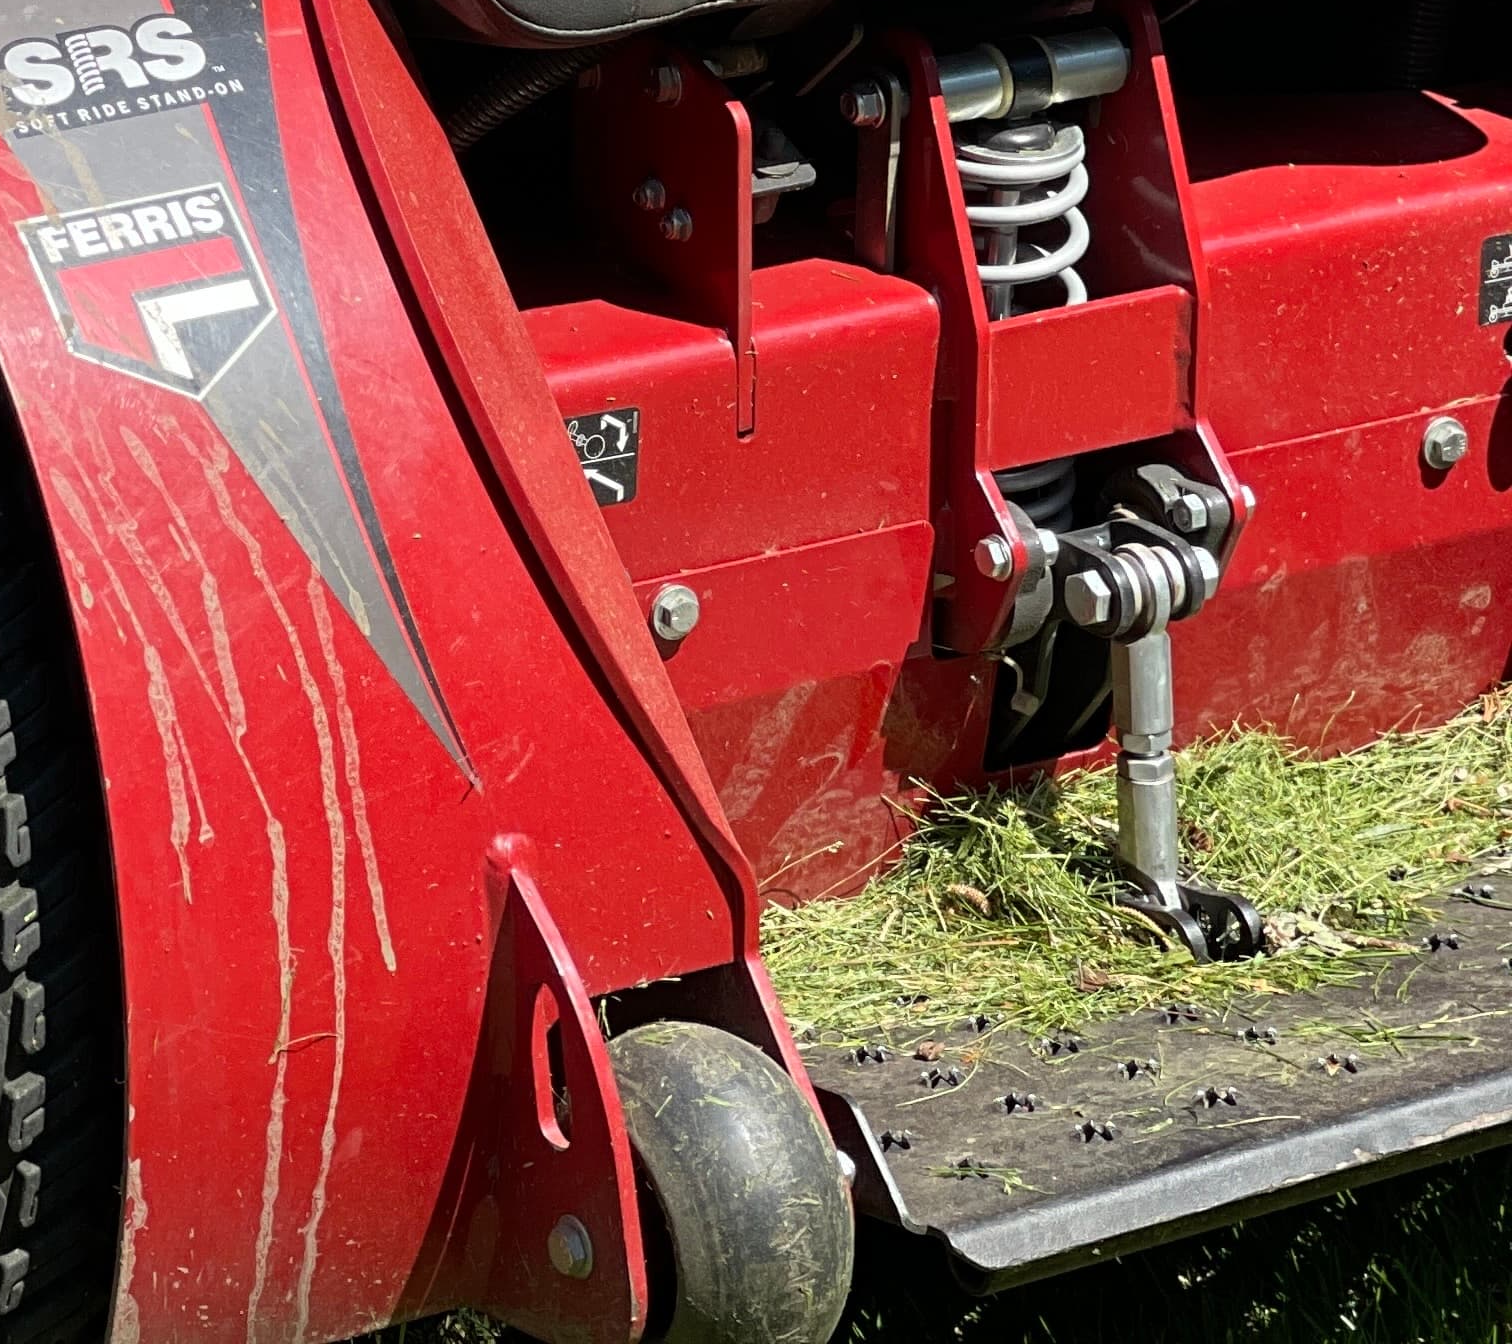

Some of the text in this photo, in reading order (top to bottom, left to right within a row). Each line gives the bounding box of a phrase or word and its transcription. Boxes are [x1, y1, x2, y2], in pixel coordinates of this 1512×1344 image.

[3, 16, 207, 106] SRS
[15, 78, 245, 134] SOFT RIDE STAND-ON
[37, 194, 225, 263] FERRIS
